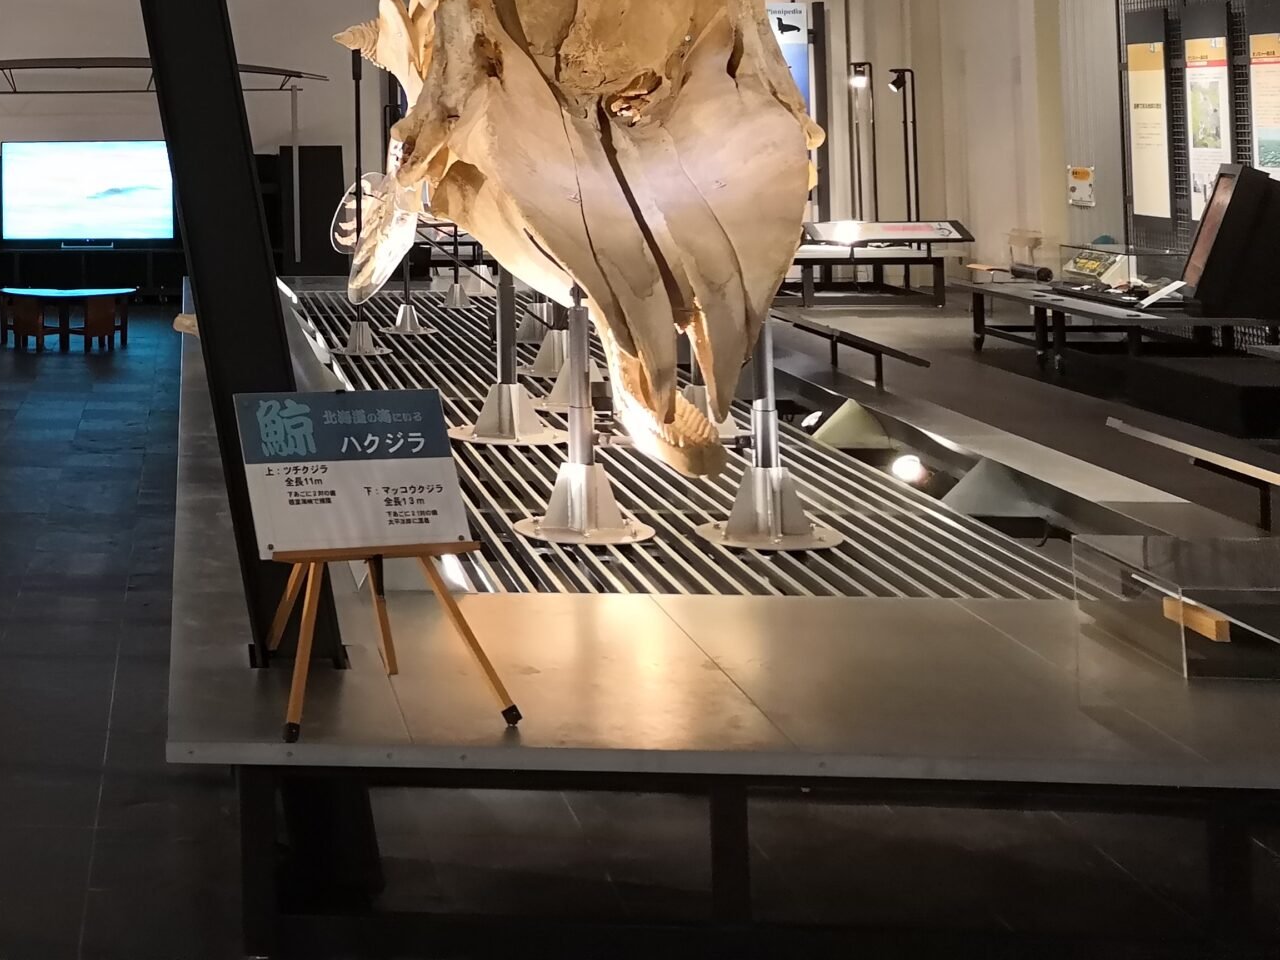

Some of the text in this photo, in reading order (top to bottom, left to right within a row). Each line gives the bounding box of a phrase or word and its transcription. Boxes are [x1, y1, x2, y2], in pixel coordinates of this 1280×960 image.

[255, 399, 317, 456] 鯨
[341, 431, 426, 454] ハクジラ
[284, 476, 324, 487] 全長11m
